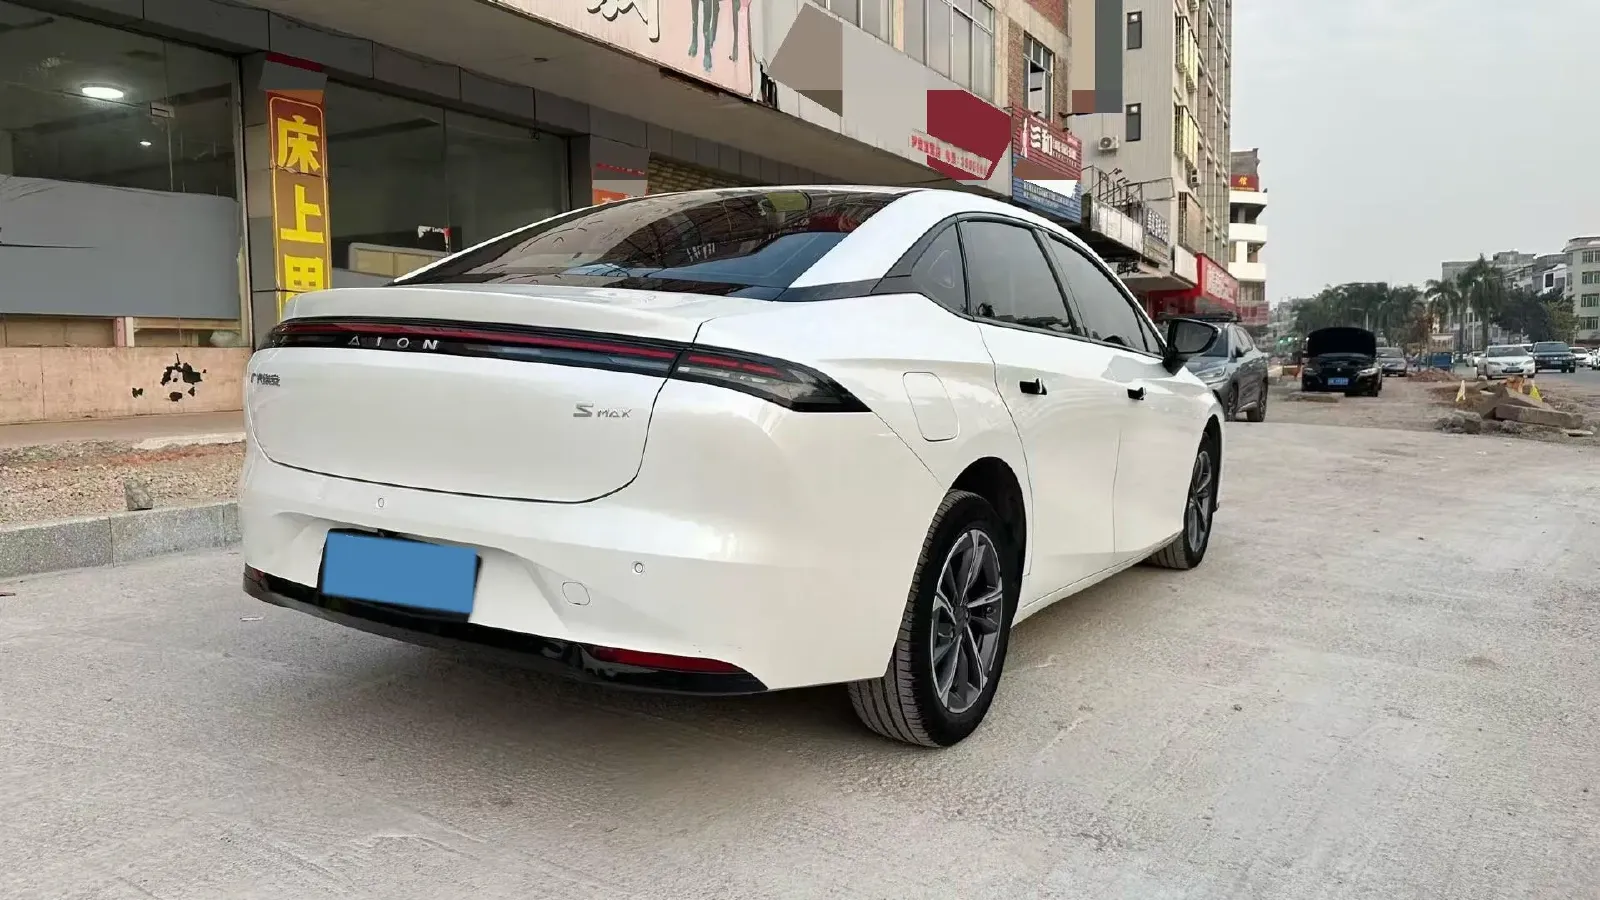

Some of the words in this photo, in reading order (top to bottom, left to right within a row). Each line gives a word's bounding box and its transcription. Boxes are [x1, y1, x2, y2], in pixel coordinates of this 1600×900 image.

[348, 335, 439, 350] AION
[573, 402, 594, 418] S
[597, 408, 632, 418] MAX
